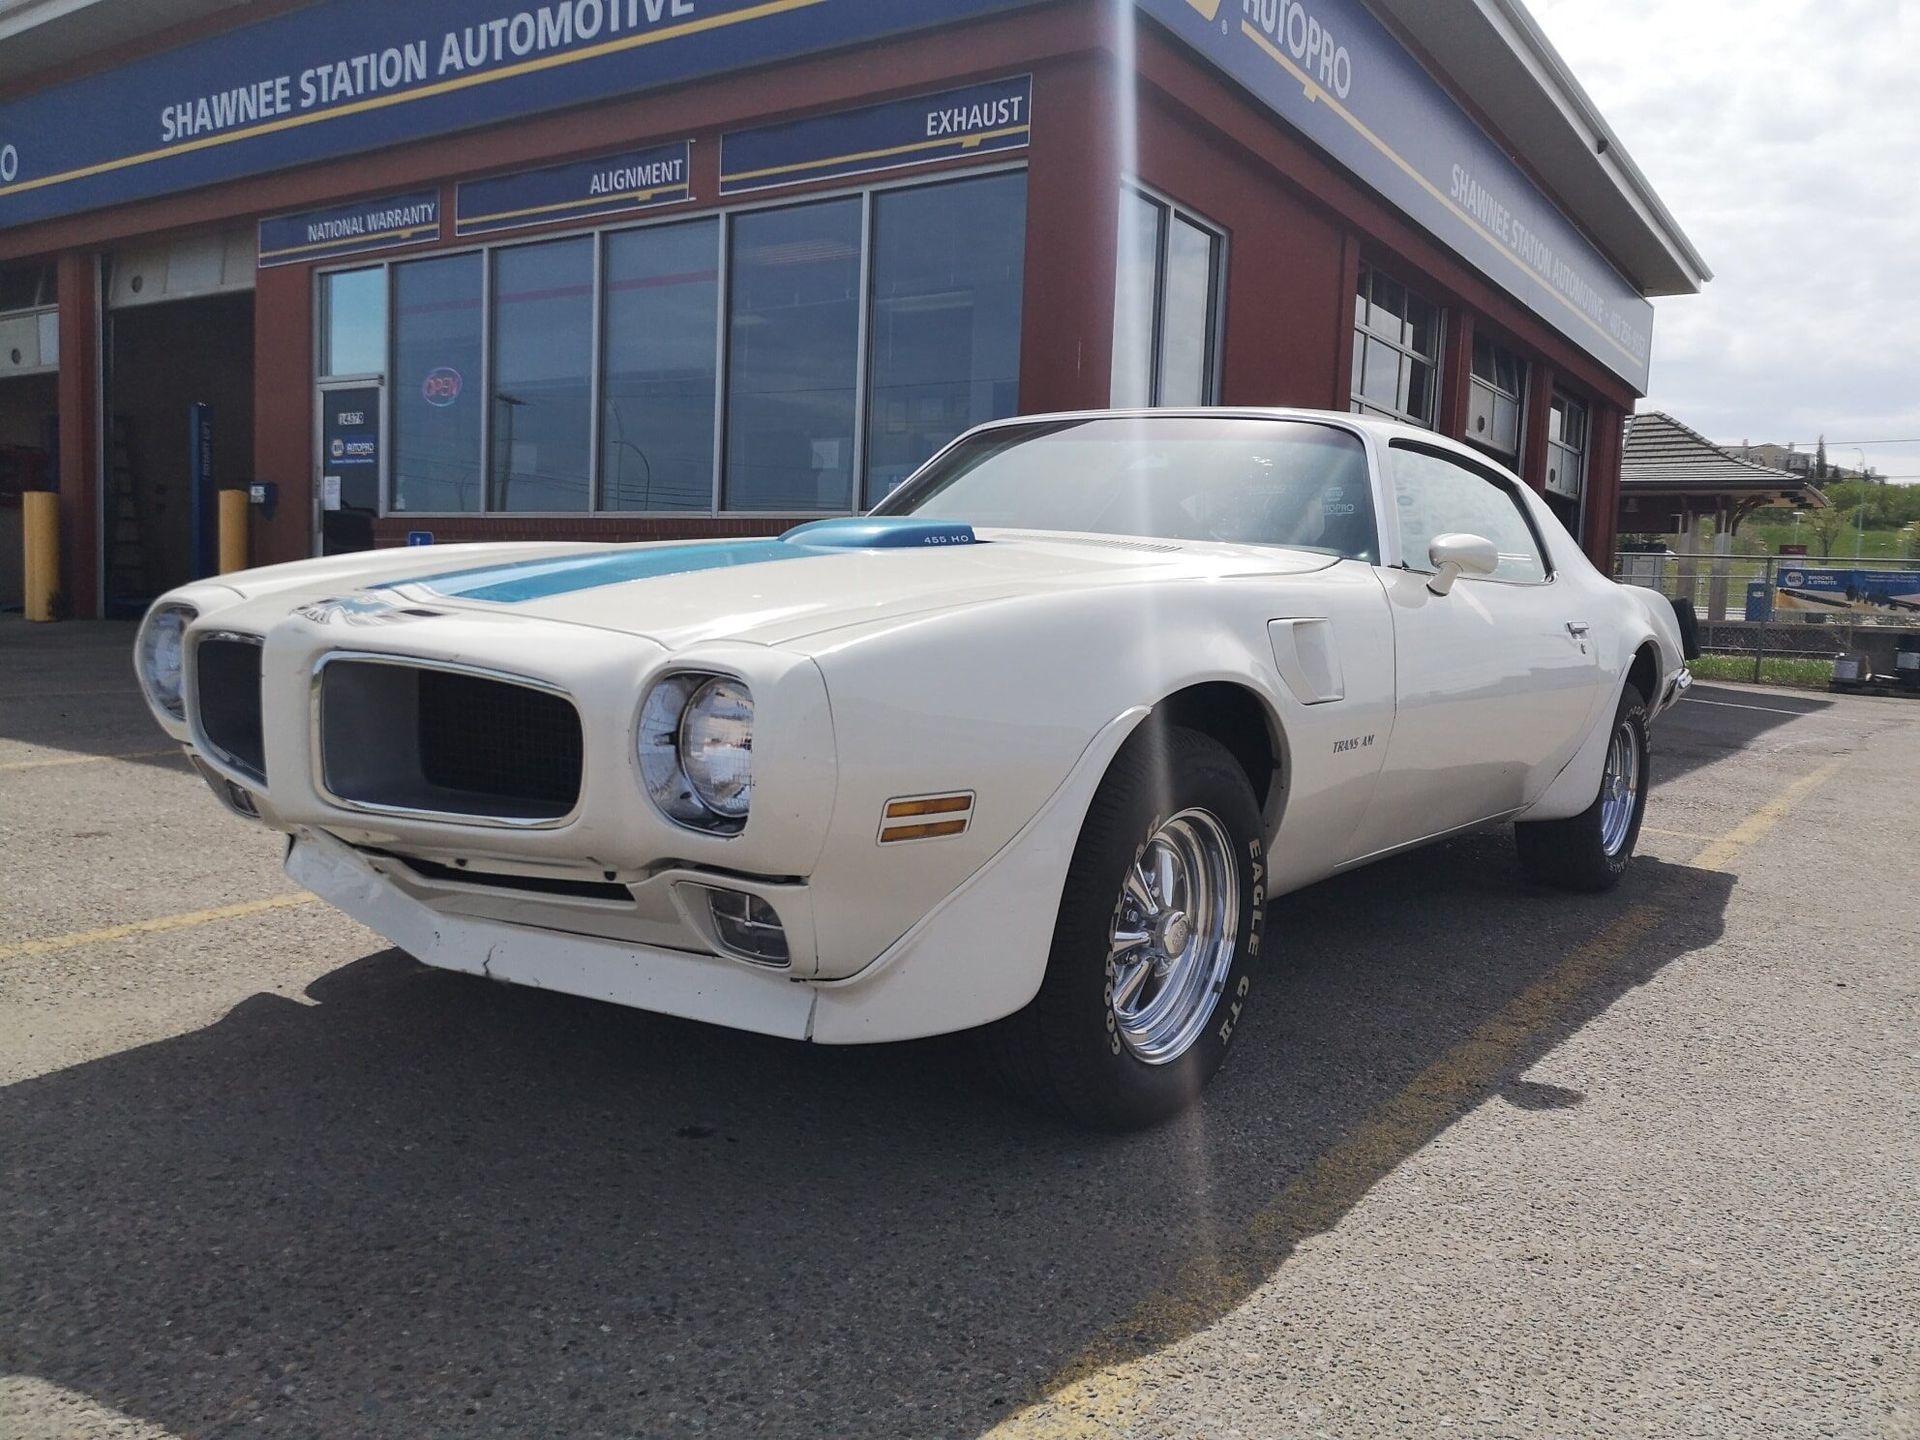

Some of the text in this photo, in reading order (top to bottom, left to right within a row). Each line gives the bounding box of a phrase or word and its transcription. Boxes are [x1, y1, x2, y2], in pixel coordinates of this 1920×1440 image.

[161, 75, 291, 142] SHAWNEE
[300, 40, 427, 108] STATION
[926, 95, 1023, 136] EXHAUST
[590, 158, 683, 195] ALIGNMENT
[307, 202, 436, 242] NATIONAL WARRANTY
[1450, 163, 1510, 243] SHAWNEE
[1511, 219, 1552, 278] STATION
[1552, 264, 1604, 323] AUTOMOTIVE
[426, 377, 458, 397] OPEN
[346, 442, 374, 452] AUTOPRO
[924, 534, 969, 544] 455 HO
[1333, 734, 1375, 754] TRANS AM
[1248, 839, 1265, 957] EAGLE
[1230, 975, 1250, 1025] GT
